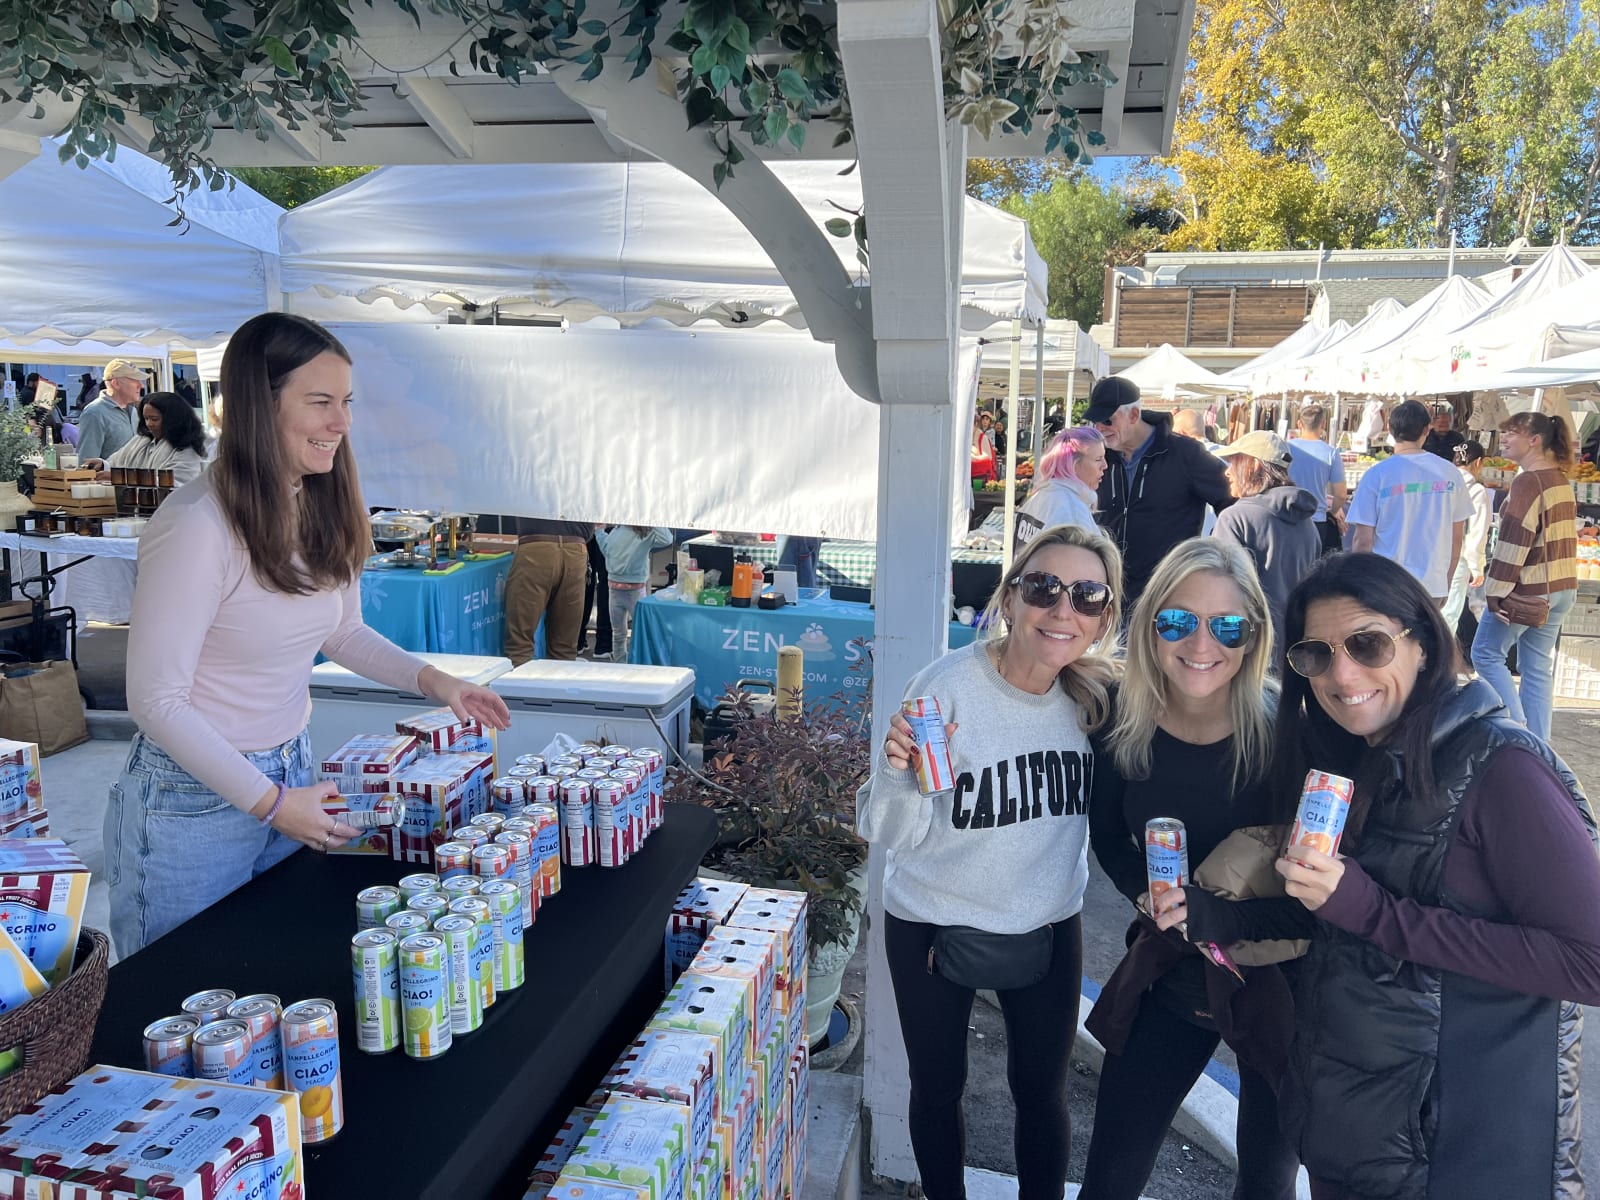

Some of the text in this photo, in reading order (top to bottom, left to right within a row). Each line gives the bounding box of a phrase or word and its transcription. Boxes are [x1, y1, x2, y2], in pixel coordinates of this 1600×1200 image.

[463, 587, 489, 615] ZEN
[722, 628, 785, 653] ZEN
[0, 785, 24, 801] IAO!
[403, 816, 430, 827] CIAO!
[1305, 811, 1339, 828] CIAO!
[403, 989, 433, 1000] CIAO!
[294, 1060, 333, 1079] CIAO!
[305, 1077, 326, 1086] PEACH
[61, 1108, 92, 1129] CIAO!
[169, 1124, 200, 1146] CIAO!
